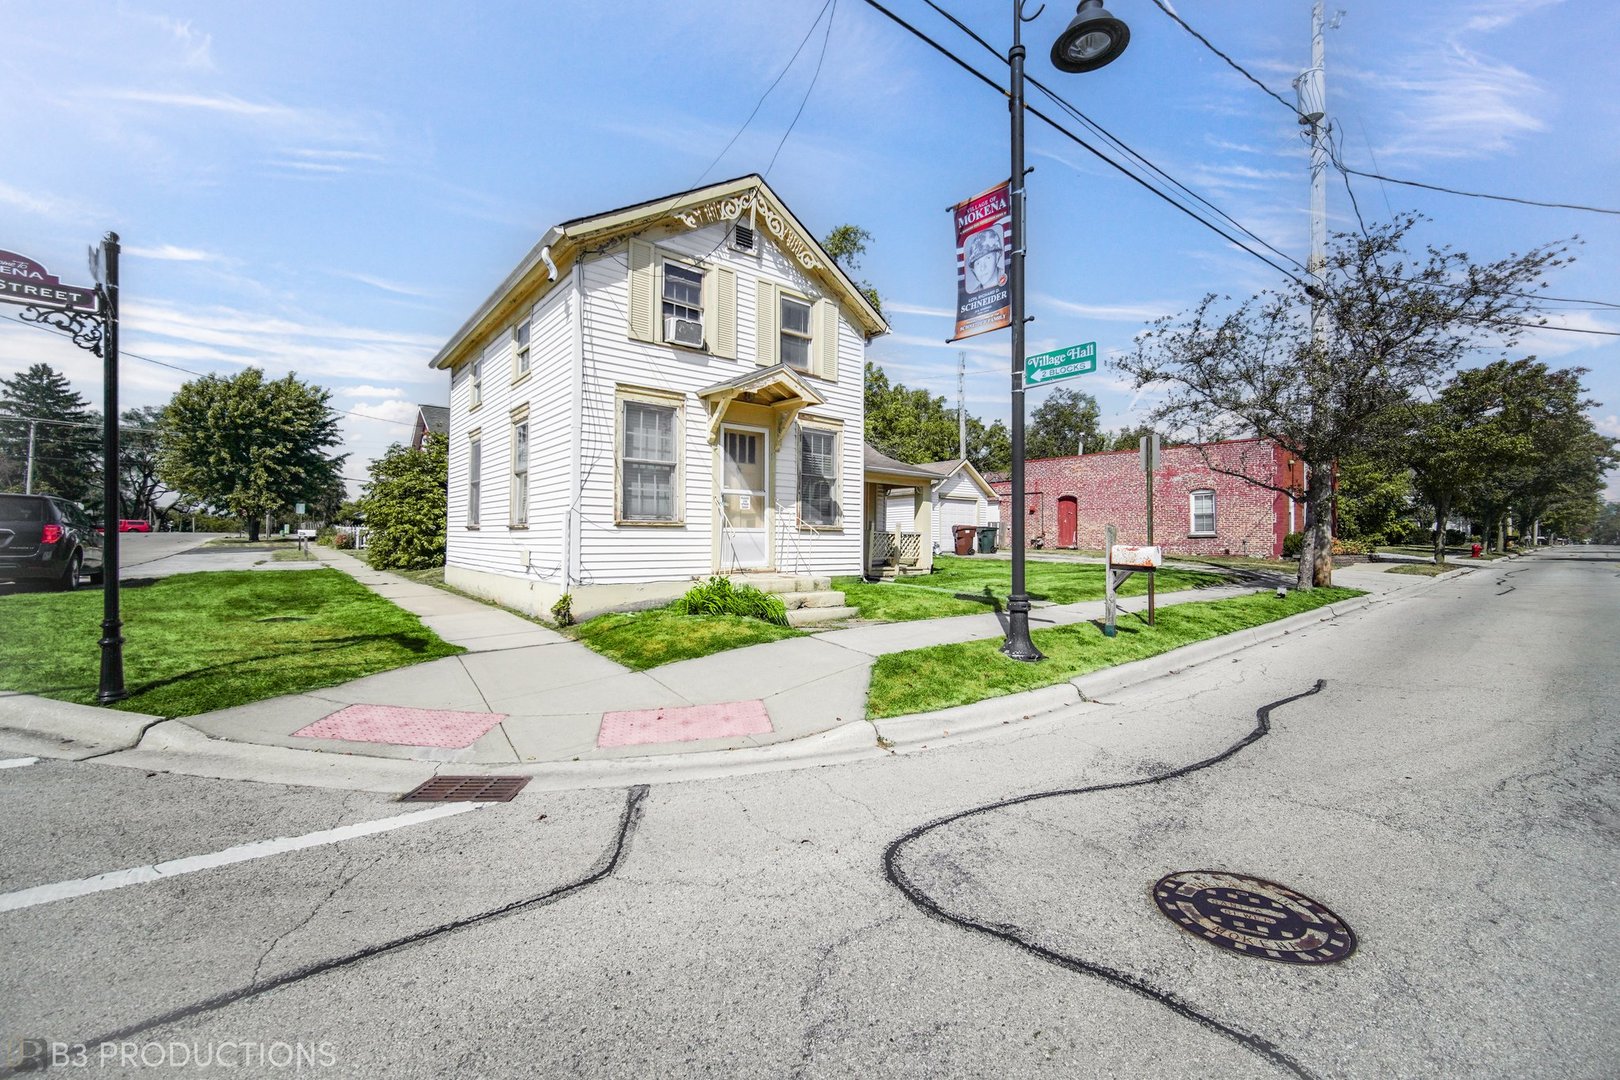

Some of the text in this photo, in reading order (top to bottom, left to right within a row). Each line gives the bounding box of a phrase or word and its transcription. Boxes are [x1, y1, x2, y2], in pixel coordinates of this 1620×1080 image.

[958, 199, 1006, 229] MOKENA
[0, 279, 82, 302] STREET
[960, 291, 1007, 313] SCHNEIDER
[1028, 344, 1094, 368] Village Hall
[1041, 363, 1086, 378] 2 BLOCKS
